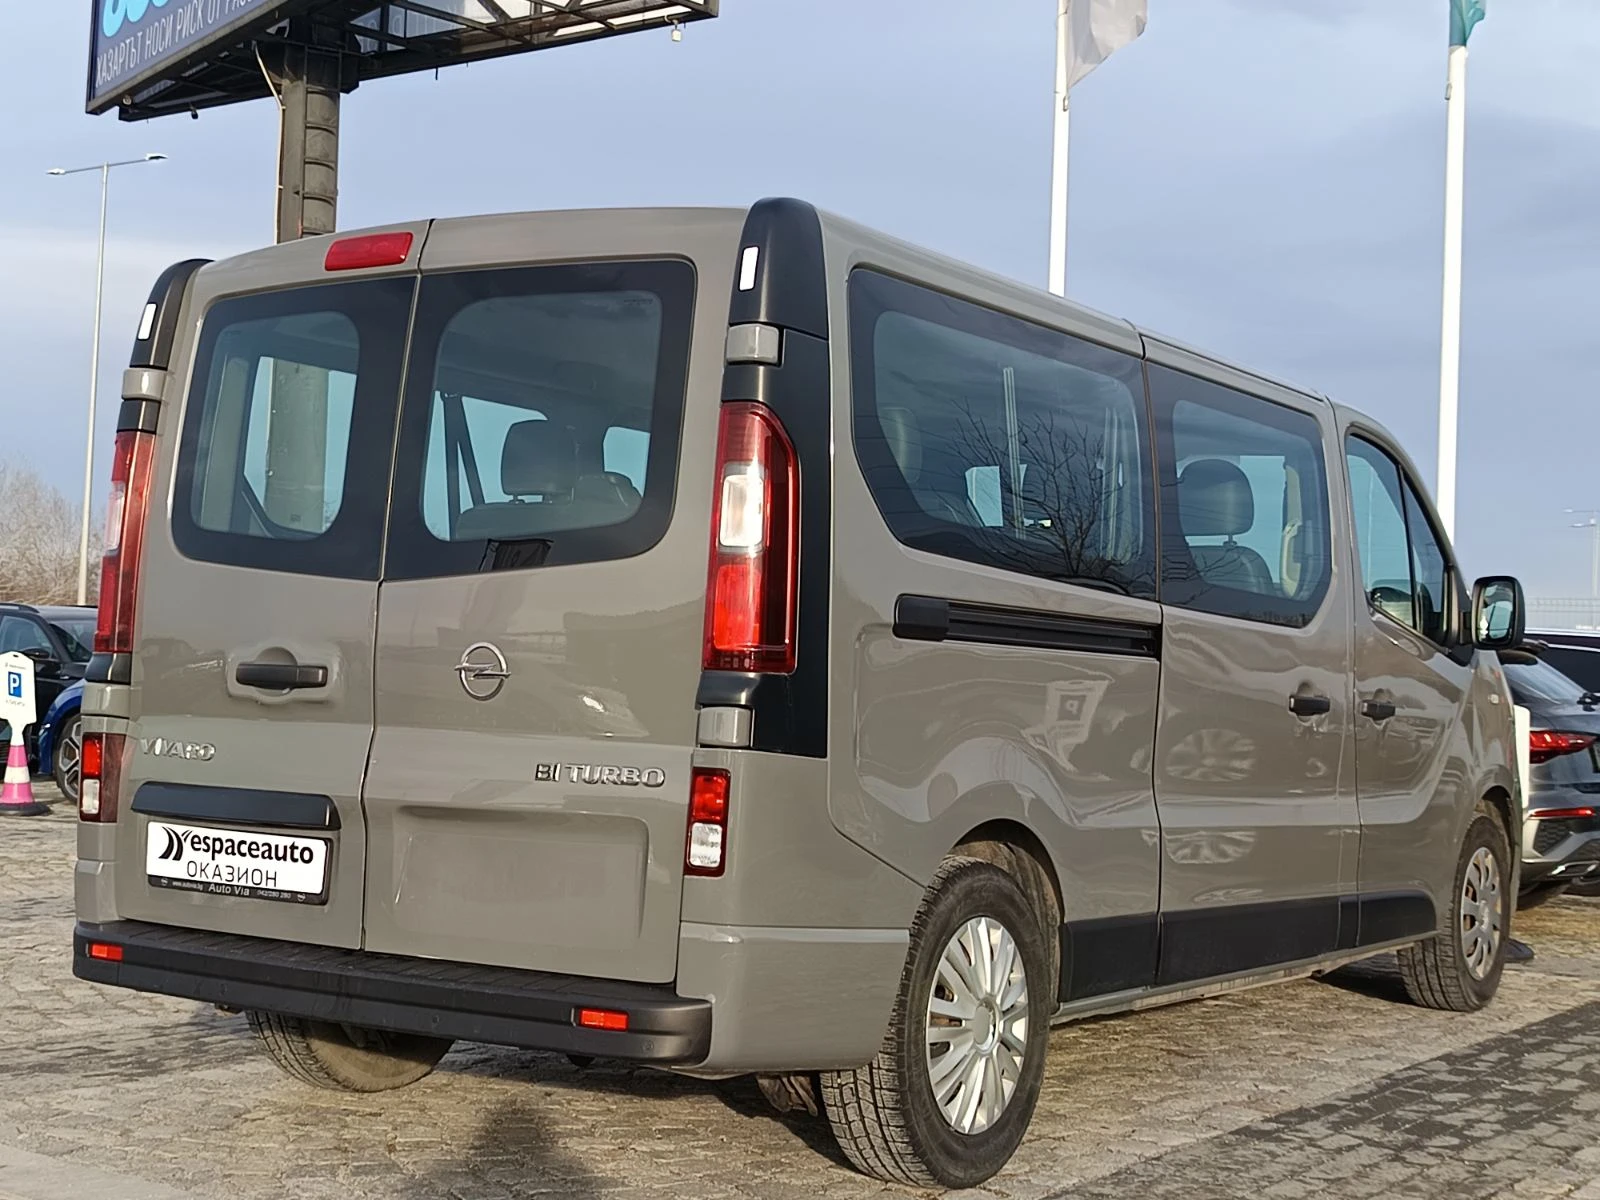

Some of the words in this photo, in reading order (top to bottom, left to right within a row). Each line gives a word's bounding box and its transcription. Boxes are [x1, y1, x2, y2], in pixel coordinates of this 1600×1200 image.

[95, 32, 143, 88] ХАЗАРТЪТ
[144, 14, 174, 60] НОСИ
[175, 0, 205, 43] РИСК
[9, 673, 20, 695] P
[140, 737, 216, 761] VIVARO
[564, 763, 666, 788] TURBO
[190, 834, 314, 864] espaceauto
[186, 860, 278, 888] ОКАЗИОН
[208, 883, 232, 894] Auto
[233, 886, 250, 898] Via
